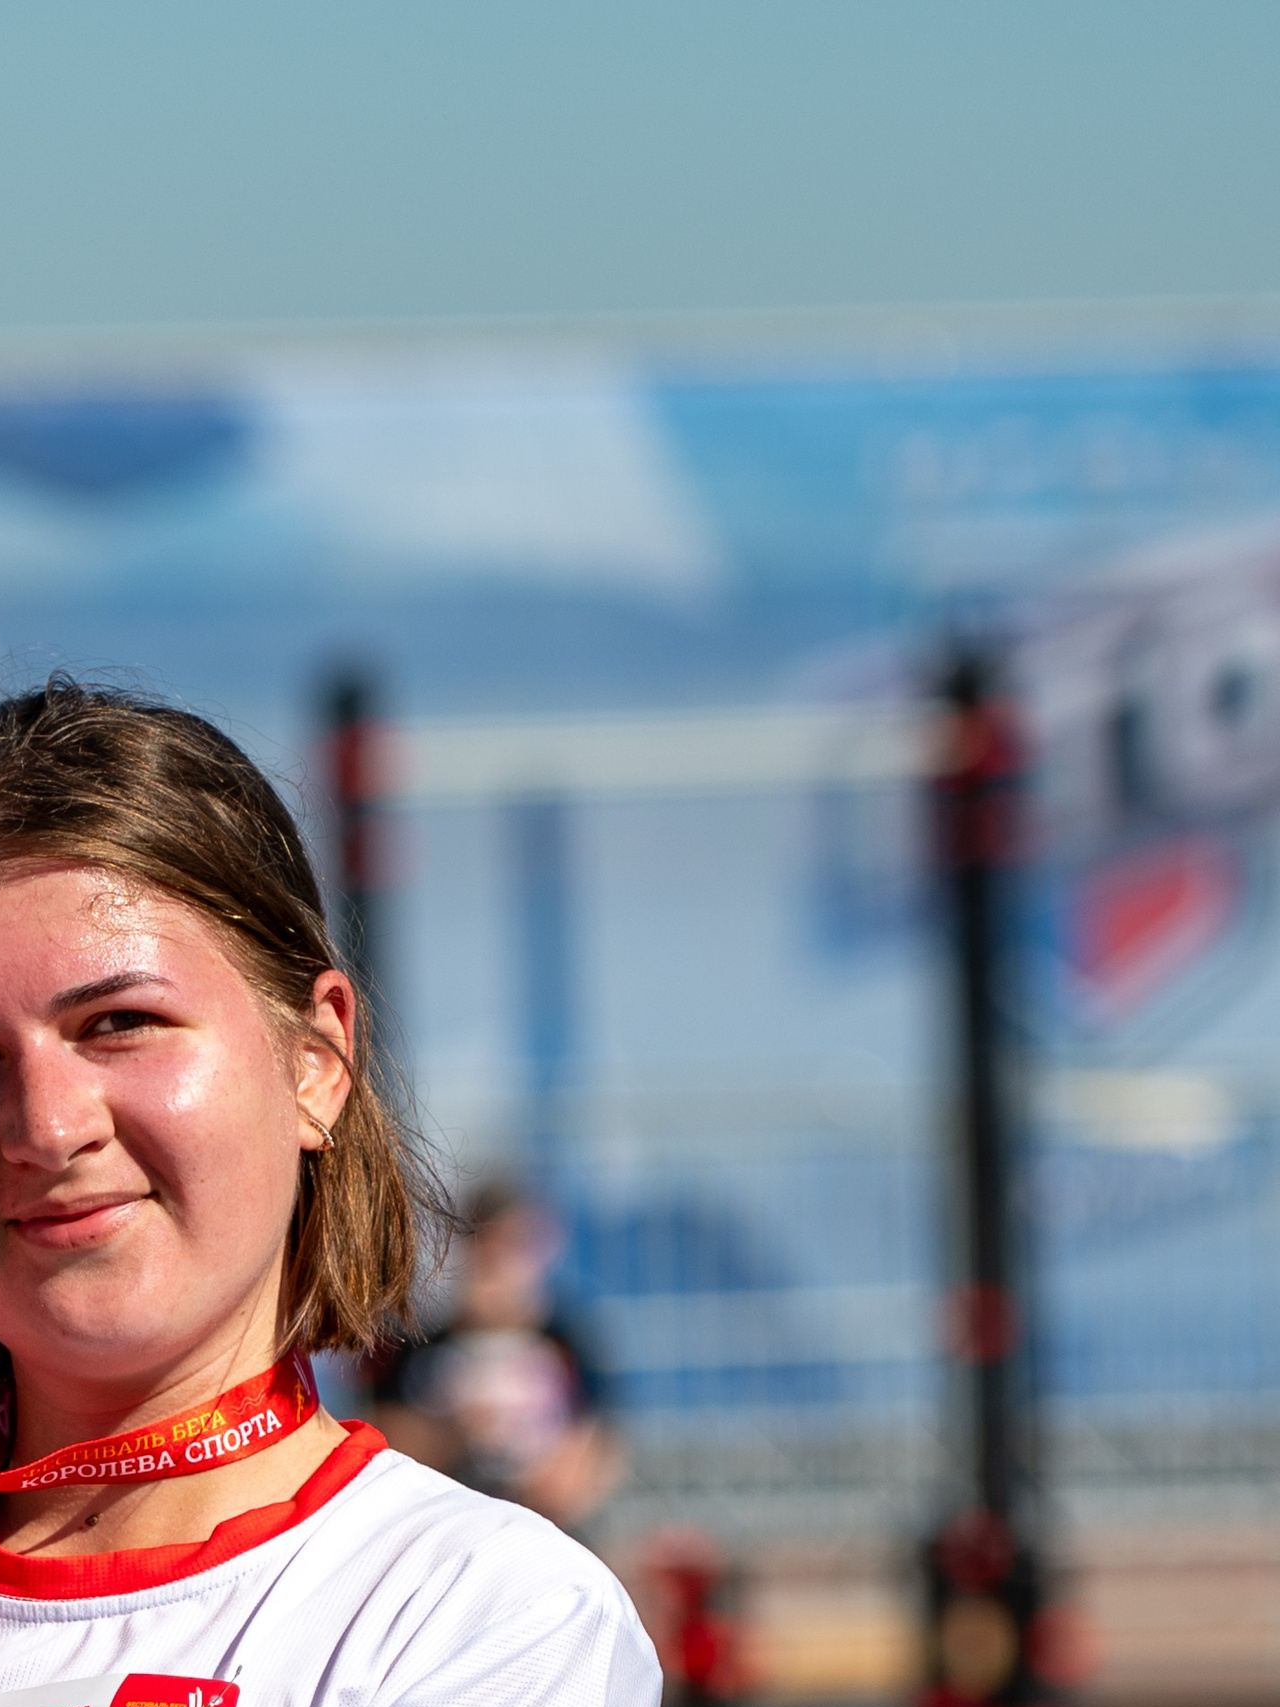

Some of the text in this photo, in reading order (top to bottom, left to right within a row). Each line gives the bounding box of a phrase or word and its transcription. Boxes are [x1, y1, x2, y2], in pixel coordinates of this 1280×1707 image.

[20, 1409, 283, 1489] КОРОЛЕВА СПОРТА
[22, 1409, 227, 1478] ФЕСТИВАЛЬ БЕГА
